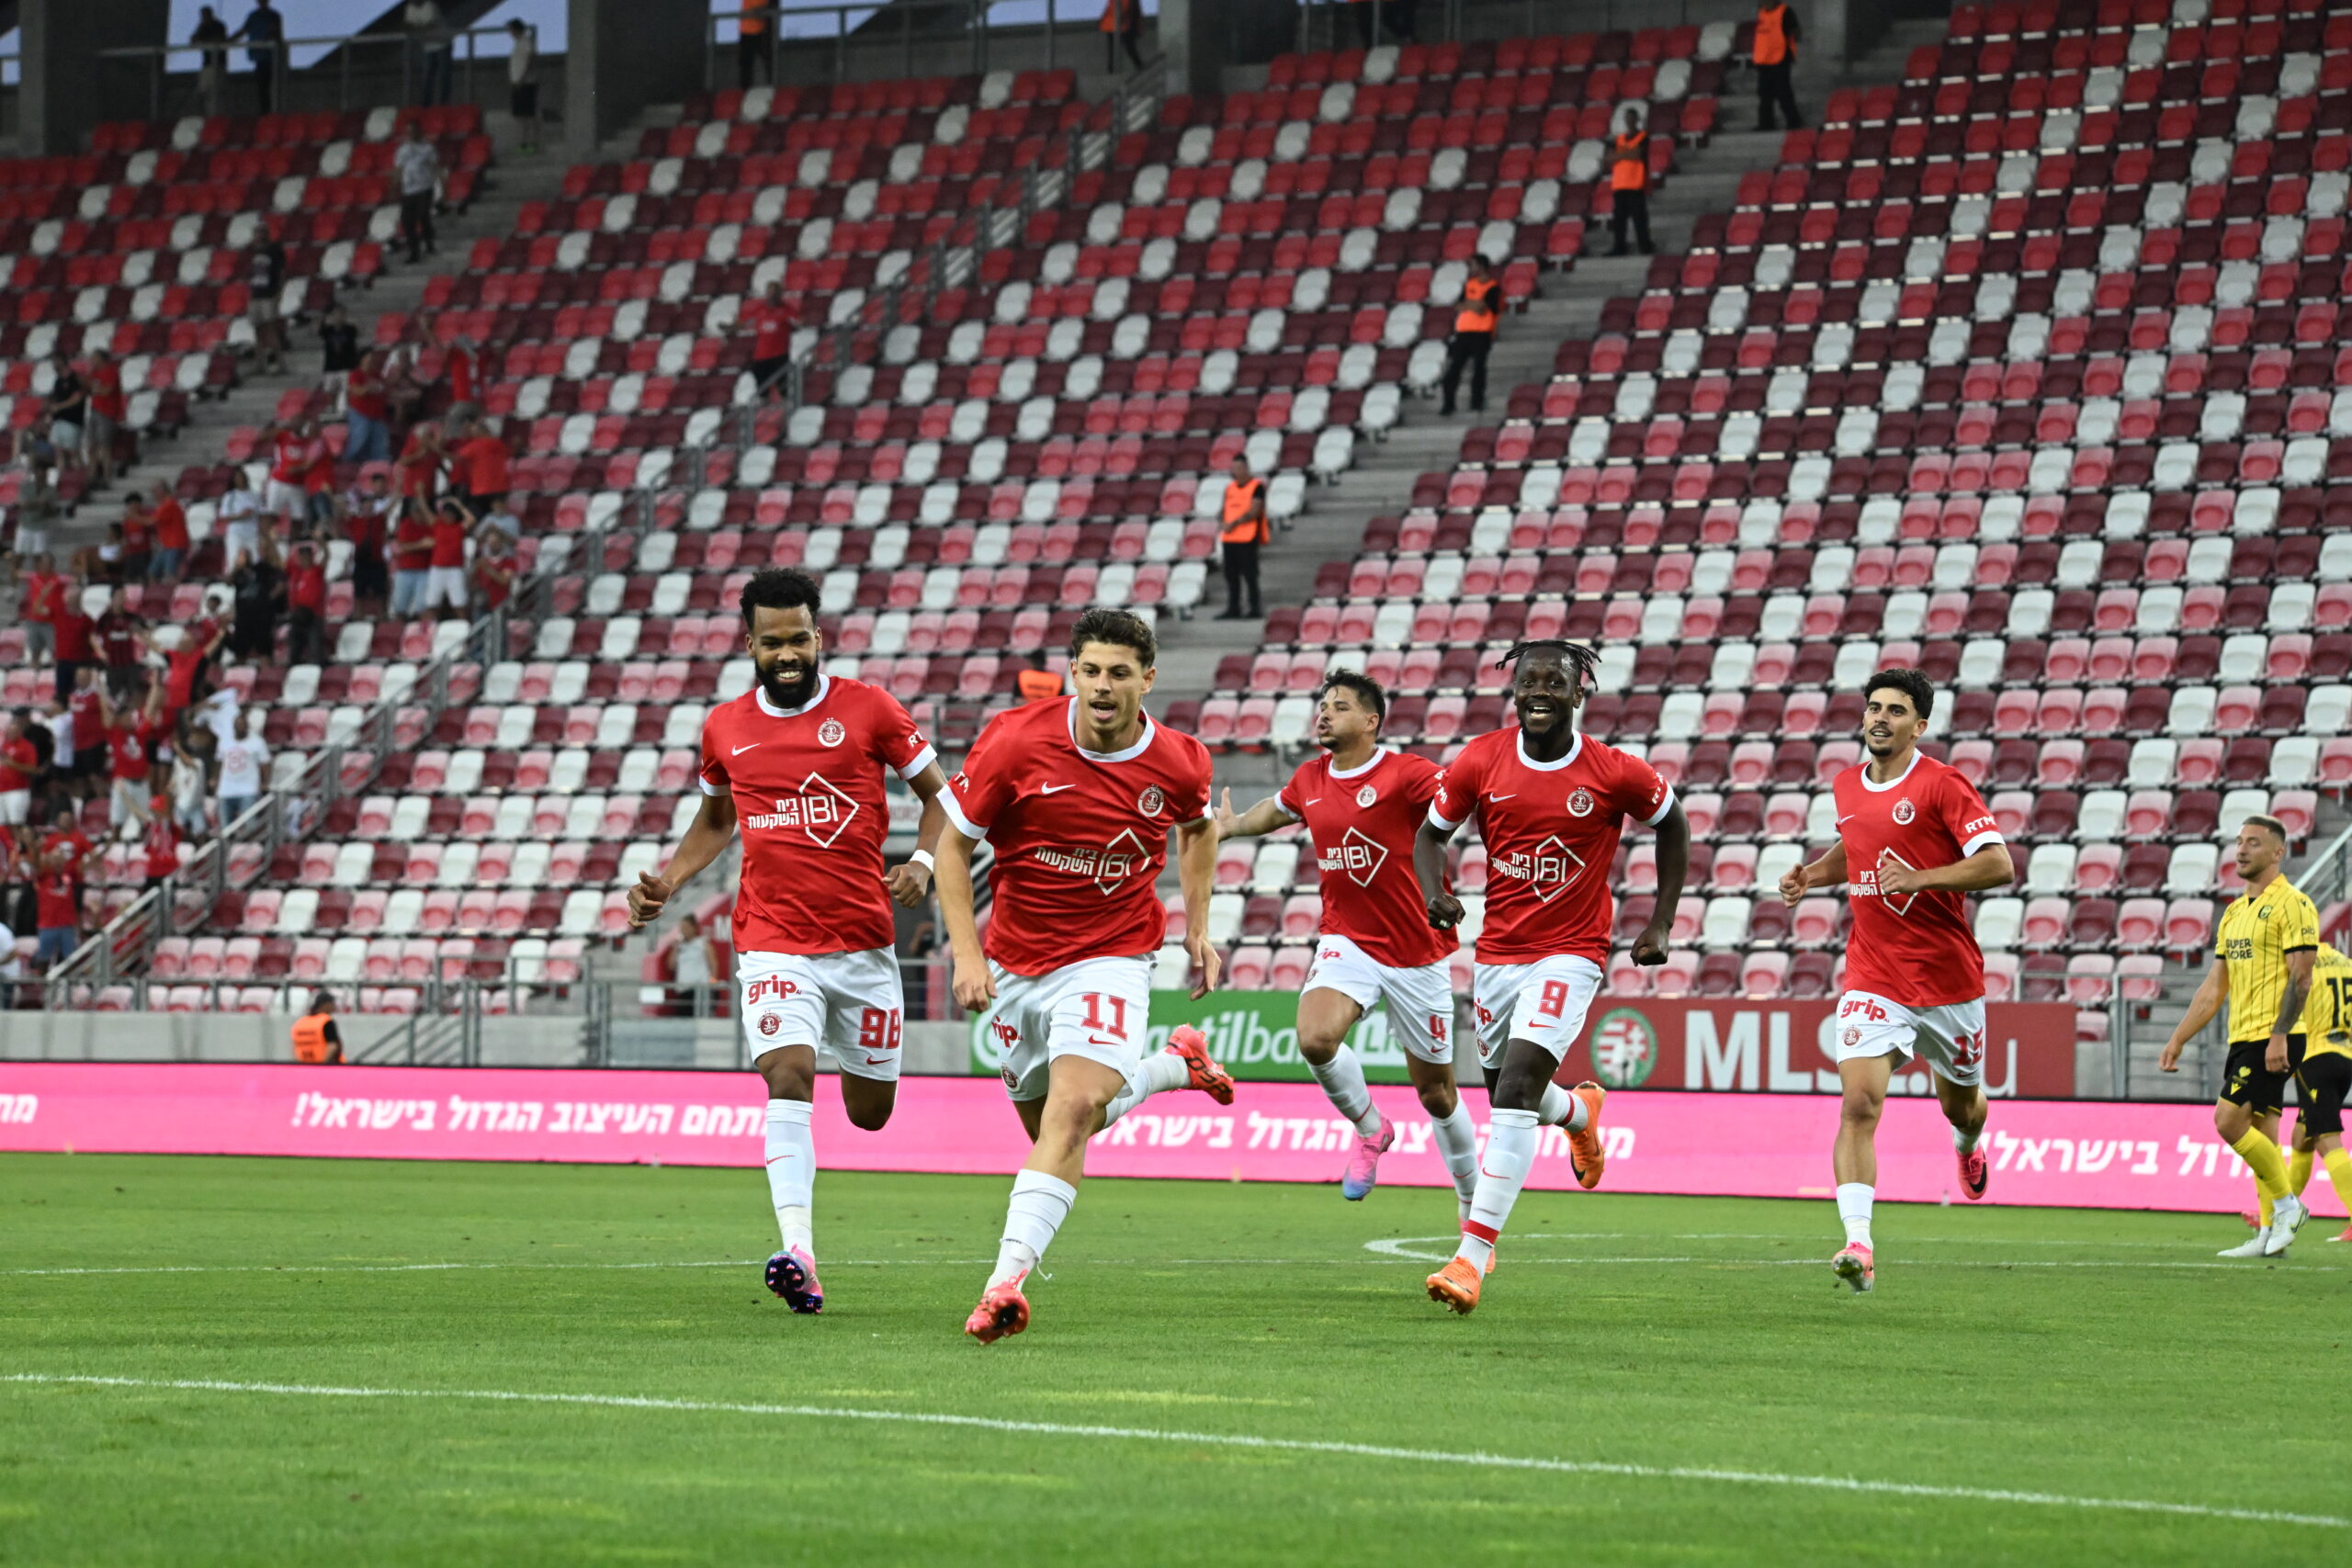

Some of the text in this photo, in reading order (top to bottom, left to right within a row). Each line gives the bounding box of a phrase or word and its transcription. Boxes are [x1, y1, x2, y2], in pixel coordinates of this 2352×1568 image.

[909, 730, 923, 748] RT
[955, 772, 969, 794] TM
[775, 797, 798, 812] בית
[801, 795, 839, 824] IBI
[748, 812, 800, 829] השקעות
[1964, 815, 1996, 834] RTM
[1035, 847, 1094, 875] השקעות
[1327, 847, 1342, 859] בית
[1343, 845, 1372, 869] IBI
[1511, 852, 1531, 868] בית
[1533, 856, 1566, 882] IBI
[1860, 870, 1876, 883] בית
[749, 975, 797, 1005] grip
[1538, 979, 1570, 1020] 9
[1080, 992, 1128, 1042] 11
[1840, 998, 1886, 1021] grip
[859, 1007, 901, 1049] 98
[991, 1015, 1017, 1048] rip
[1952, 1025, 1983, 1066] 15
[290, 1090, 768, 1137] תחם העיצוב הגדול בישראל!
[1247, 1110, 1355, 1152] הגדול
